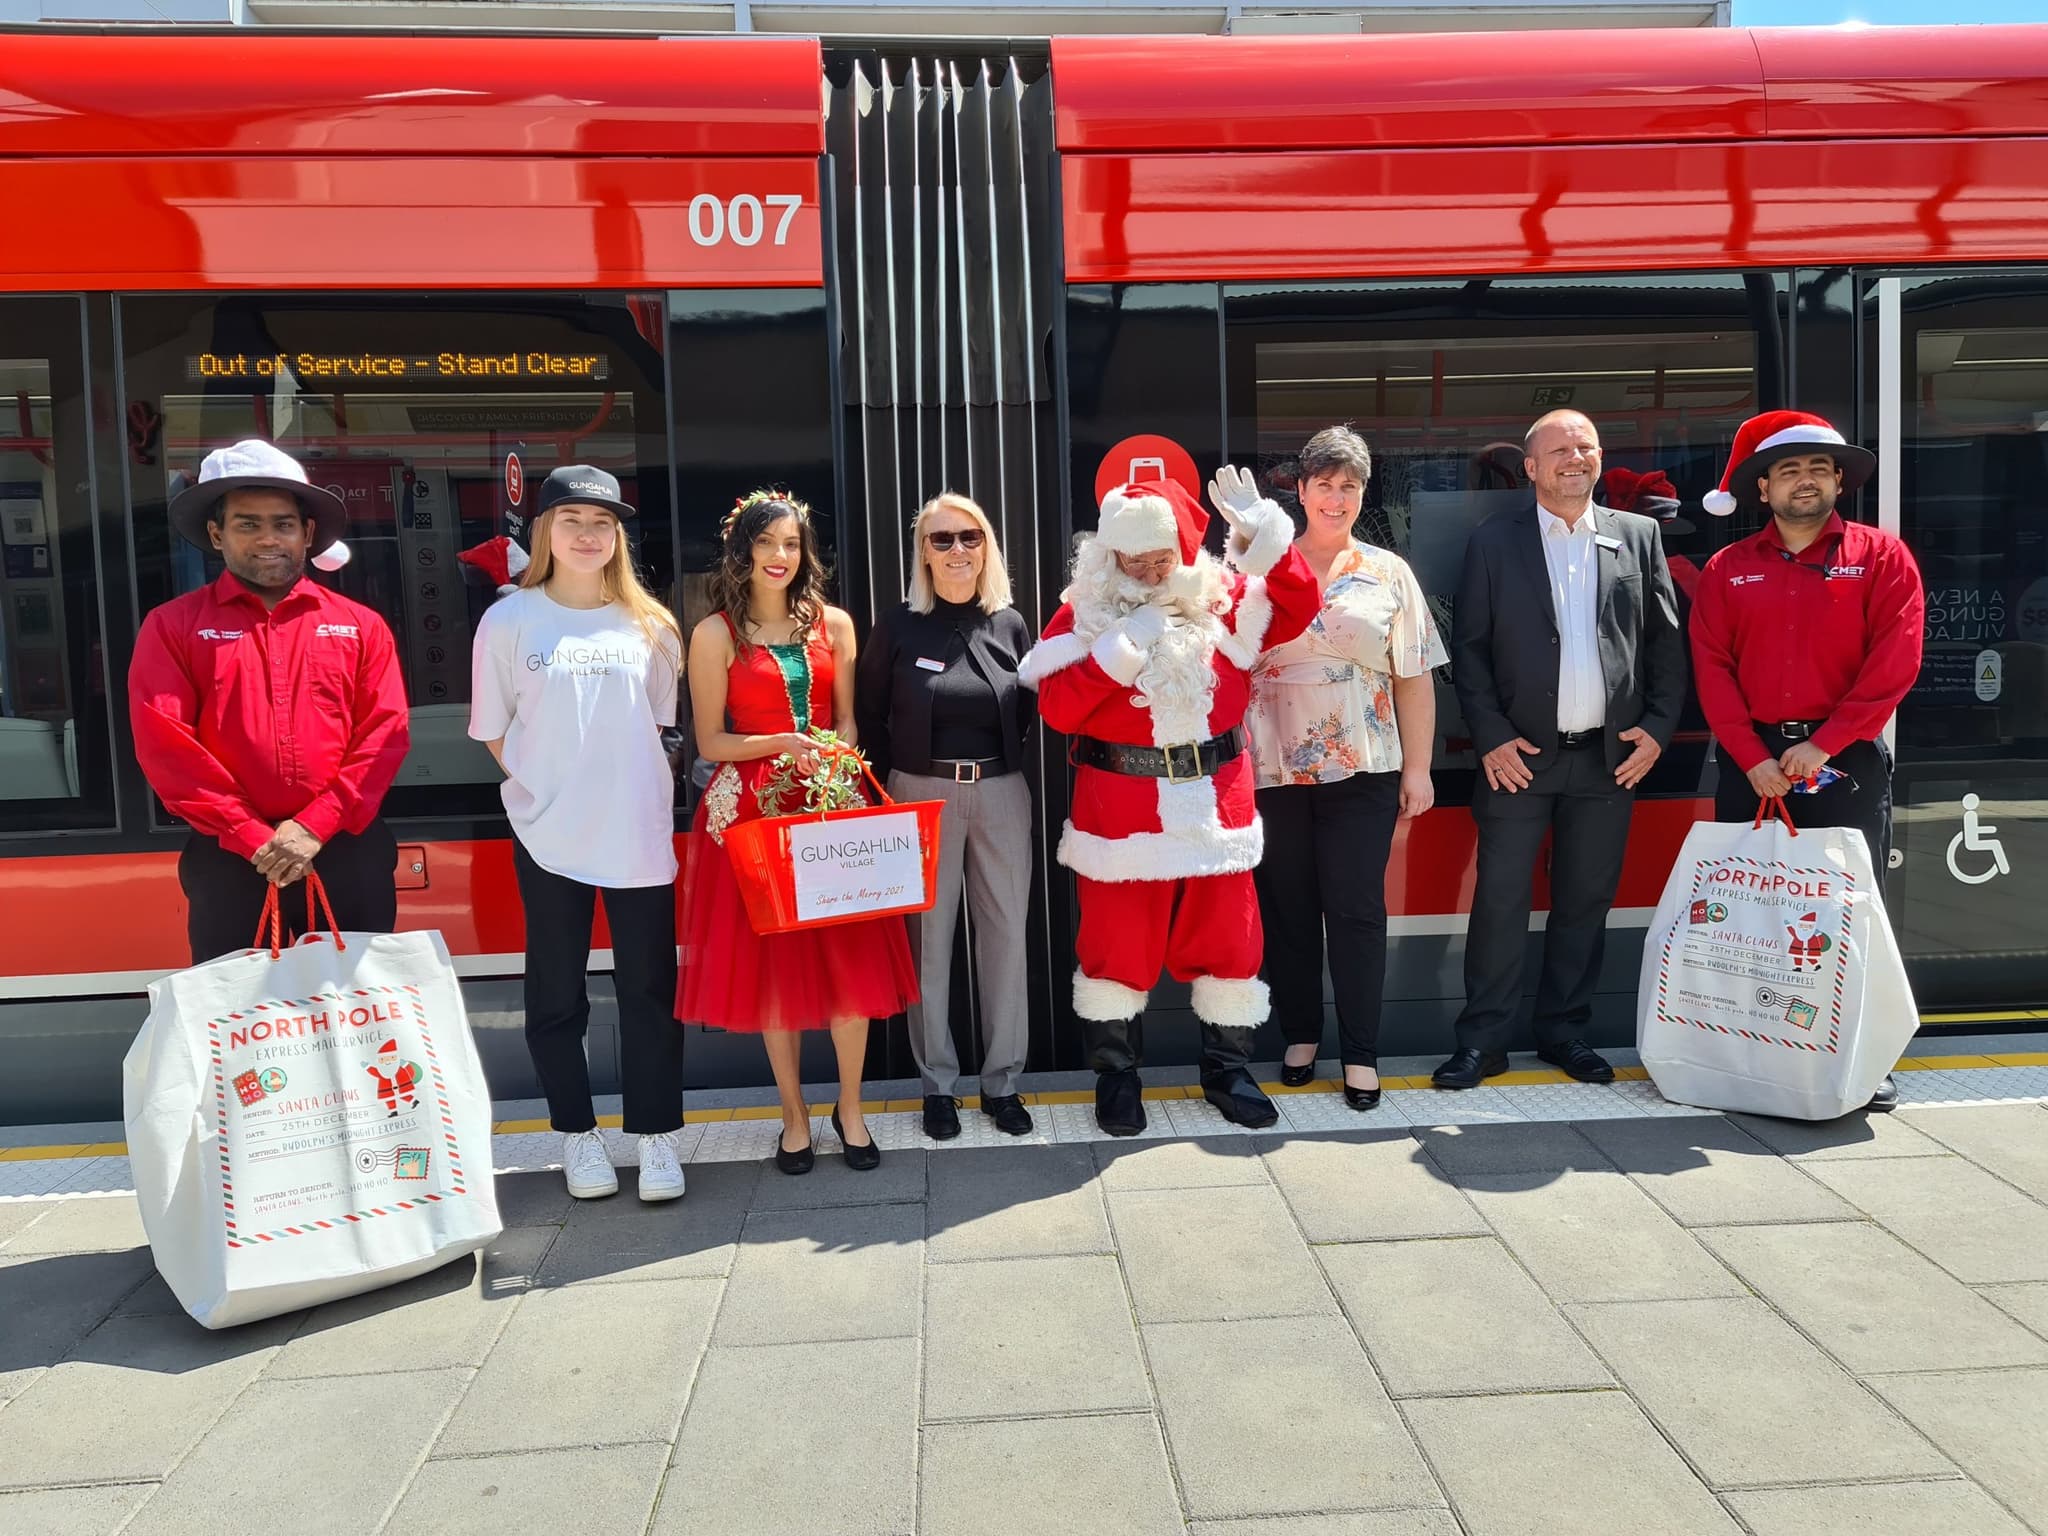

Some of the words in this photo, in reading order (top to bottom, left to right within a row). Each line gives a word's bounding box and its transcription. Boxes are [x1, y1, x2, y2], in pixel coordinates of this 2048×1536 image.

[688, 193, 802, 246] 007
[199, 353, 247, 375] Out
[256, 353, 288, 375] of
[298, 353, 405, 375] Service
[437, 352, 519, 375] Stand
[527, 352, 598, 375] Clear
[348, 488, 368, 497] ACT
[526, 648, 647, 671] GUNGAHLIN
[569, 667, 611, 676] VILLAGE
[801, 835, 910, 863] GUNGAHLIN
[840, 858, 876, 869] VILLAGE
[1705, 868, 1771, 892] NORTH
[1773, 875, 1831, 897] POLE
[816, 894, 838, 905] Share
[842, 892, 853, 901] the
[856, 887, 881, 901] Merry
[885, 885, 904, 896] 2021
[1711, 887, 1750, 902] EXPRESS
[1711, 929, 1742, 943] SANTA
[1745, 935, 1779, 949] CLAUS
[1710, 945, 1730, 956] 25TH
[1733, 949, 1781, 965] DECEMBER
[1781, 974, 1815, 986] EXPRESS
[230, 1011, 330, 1051] NORTH
[338, 1001, 404, 1030] POLE
[255, 1043, 308, 1061] EXPRESS
[312, 1035, 339, 1053] MAIL
[239, 1081, 258, 1095] HO
[278, 1096, 321, 1116] SANTA
[324, 1088, 360, 1107] CLAUS
[282, 1119, 310, 1132] 25TH
[313, 1110, 369, 1127] DECEMBER
[282, 1133, 335, 1151] RUDOLPH'S
[337, 1127, 376, 1143] MIDNIGHT
[378, 1117, 417, 1134] EXPRESS
[253, 1191, 287, 1204] RETURN
[288, 1188, 299, 1197] TO
[350, 1183, 362, 1193] HO
